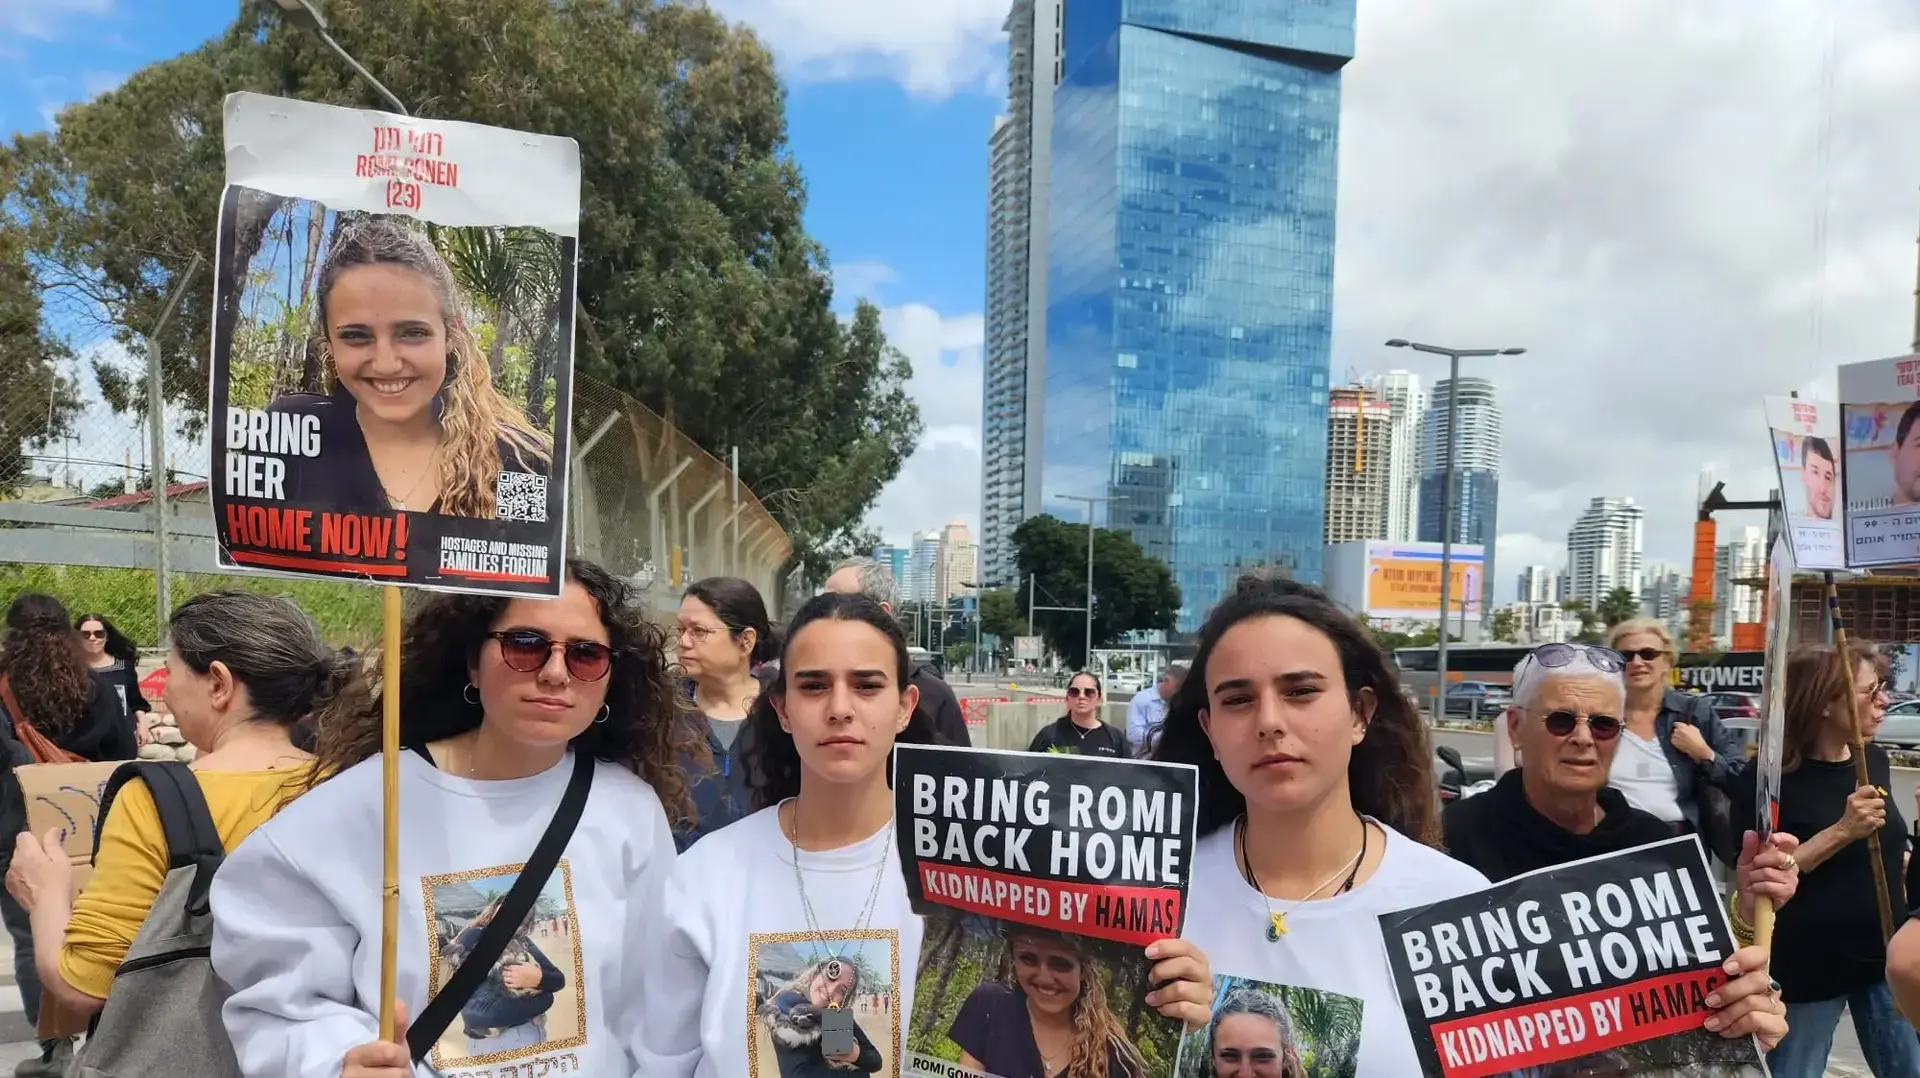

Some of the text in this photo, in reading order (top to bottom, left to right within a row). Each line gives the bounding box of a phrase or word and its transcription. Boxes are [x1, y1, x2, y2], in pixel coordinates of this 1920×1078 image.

[386, 180, 422, 212] (23)
[226, 406, 321, 458] BRING
[225, 452, 286, 500] HER
[226, 504, 409, 561] HOME NOW!
[441, 536, 548, 559] HOSTAGES AND MISSING
[1856, 535, 1884, 545] אותם
[440, 550, 548, 579] FAMILIES FORUM
[913, 773, 1182, 835] BRING ROMI
[913, 817, 1182, 884] BACK HOME
[924, 869, 1175, 934] KIDNAPPED BY HAMAS
[1402, 867, 1701, 971] BRING ROMI
[1414, 915, 1722, 1019] BACK HOME
[1440, 1005, 1586, 1068] KIDNAPPED
[1589, 997, 1623, 1037] BY
[912, 1057, 987, 1078] ROMI GON
